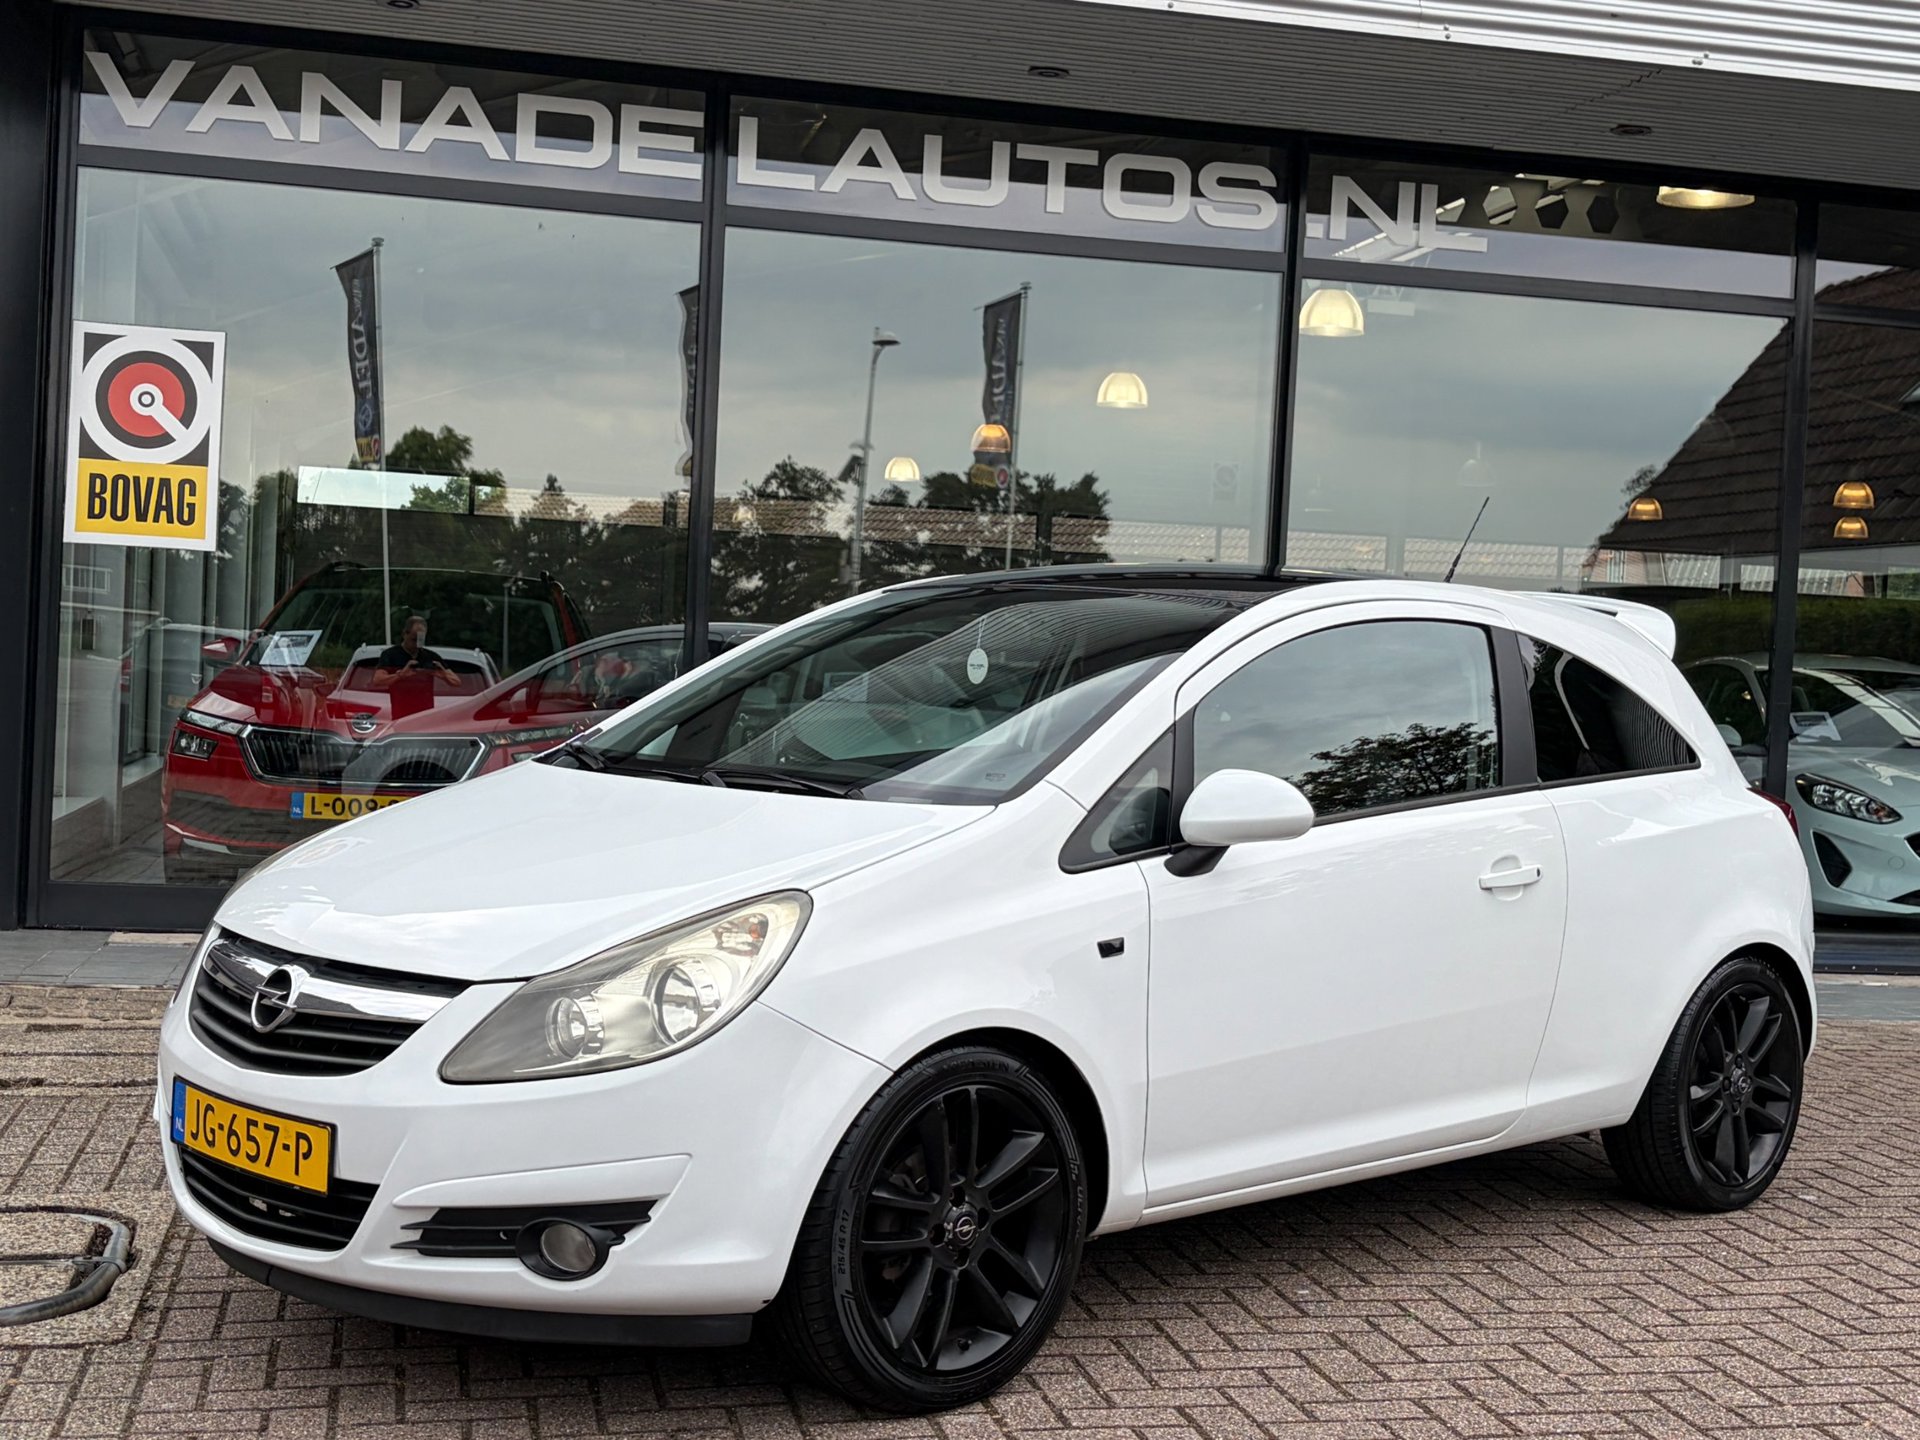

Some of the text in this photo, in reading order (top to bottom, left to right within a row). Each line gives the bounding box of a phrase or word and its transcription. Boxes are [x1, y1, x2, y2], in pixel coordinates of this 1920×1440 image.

[87, 473, 196, 526] BOVAG
[310, 796, 399, 816] L-009-
[175, 1116, 184, 1132] NL
[190, 1098, 313, 1177] JG-657-P
